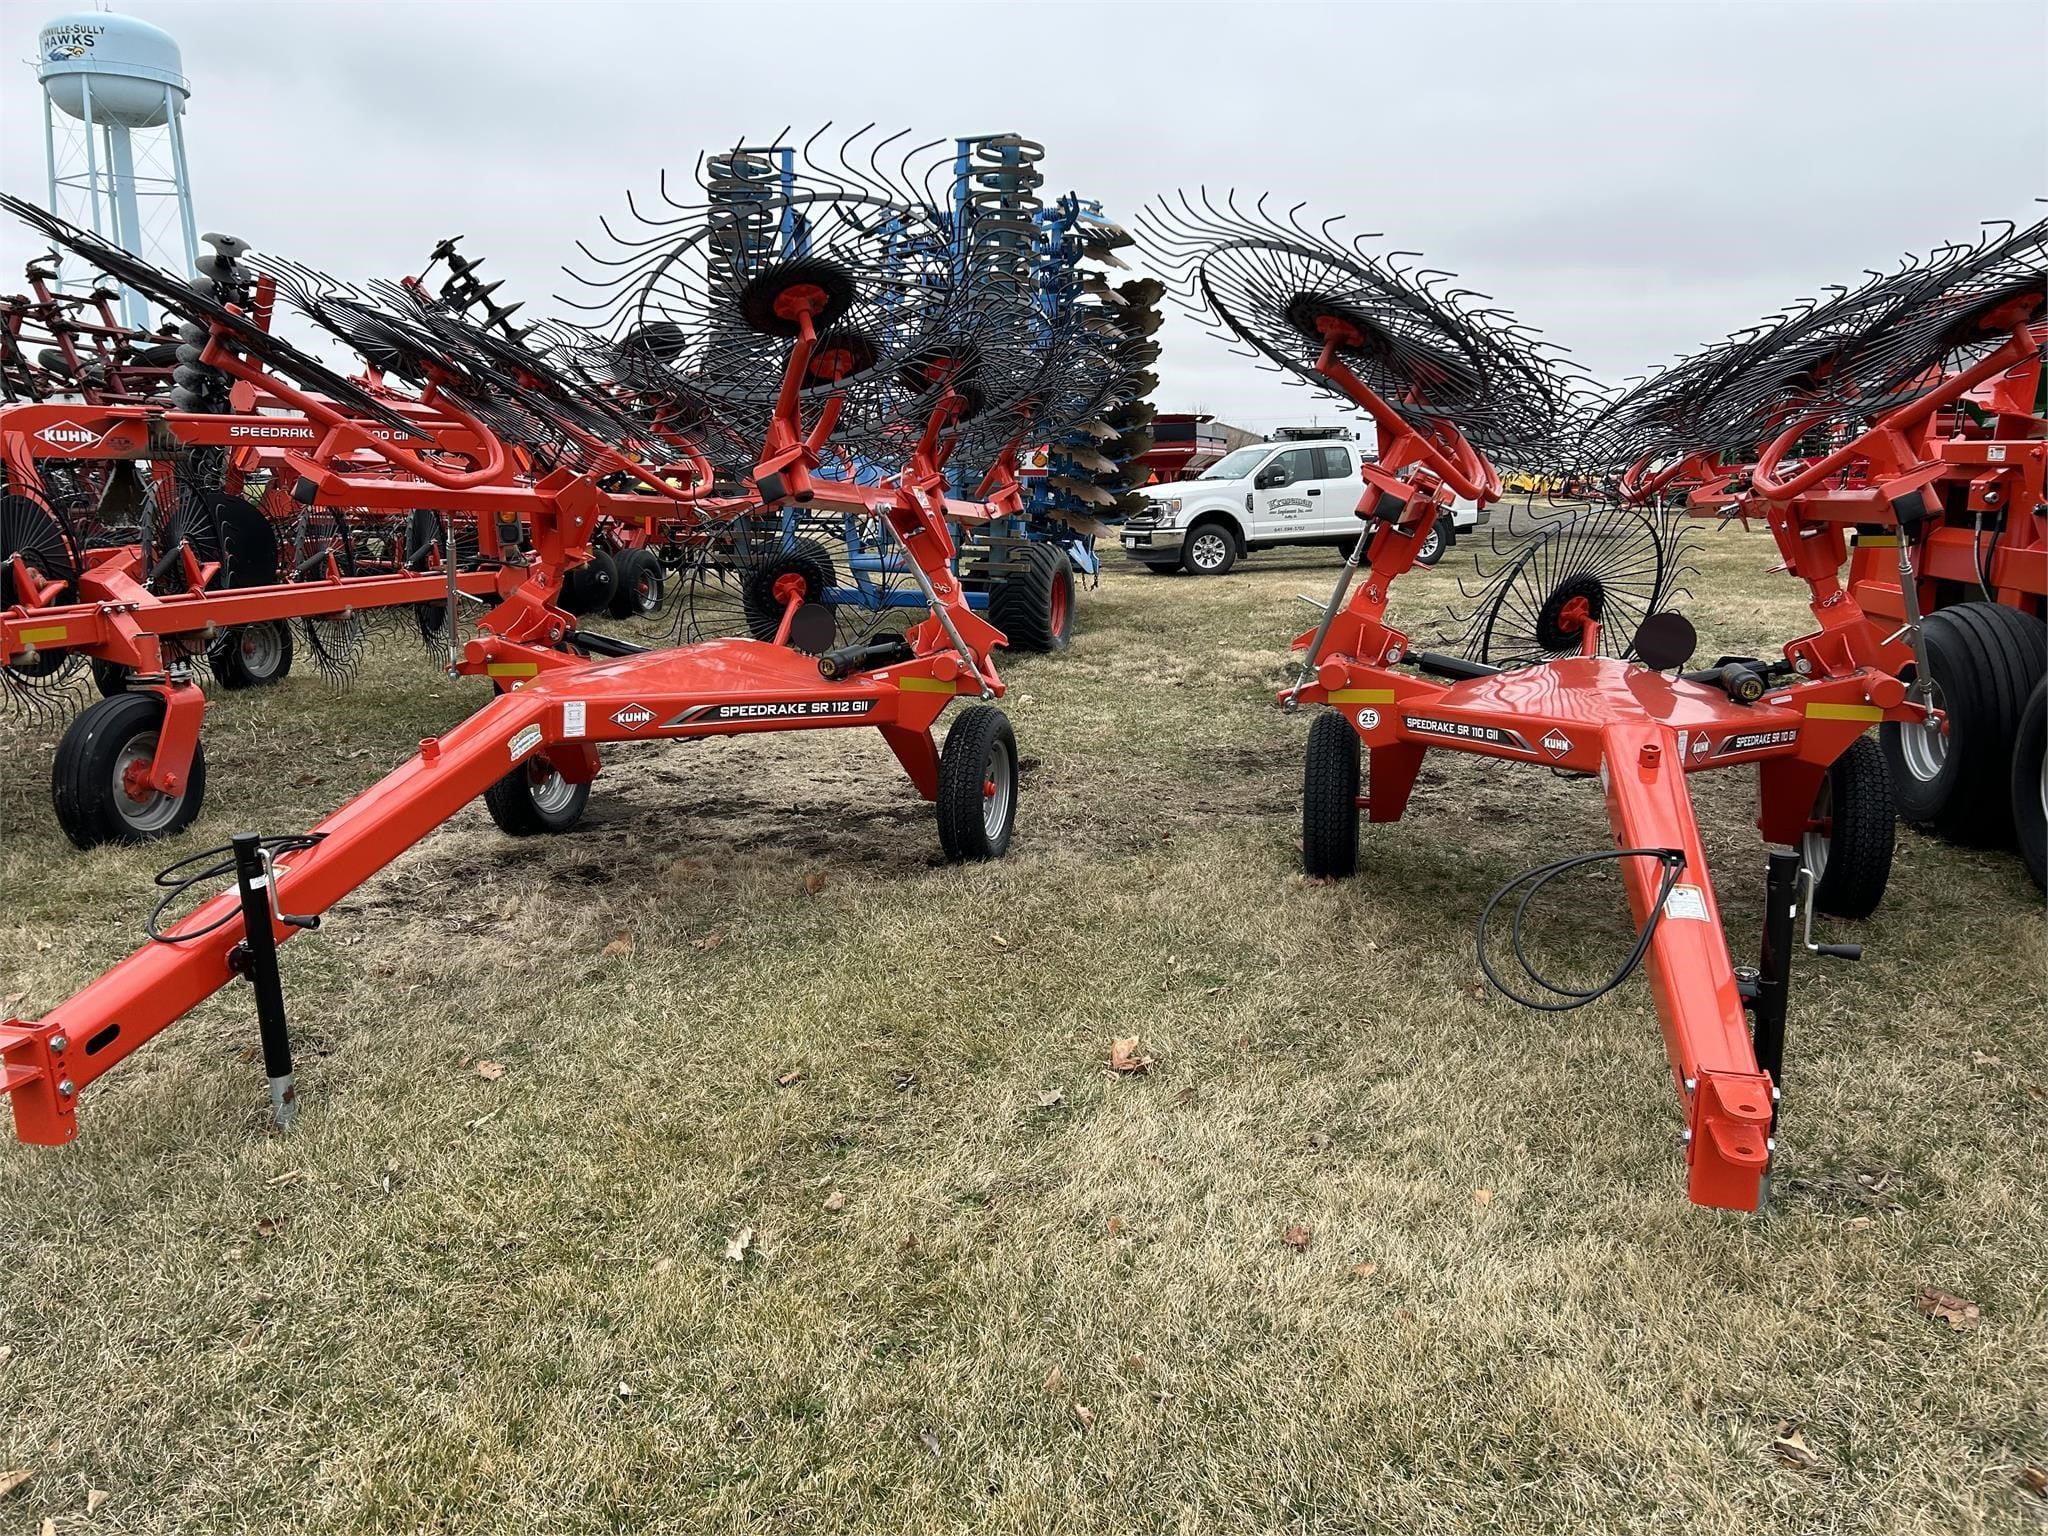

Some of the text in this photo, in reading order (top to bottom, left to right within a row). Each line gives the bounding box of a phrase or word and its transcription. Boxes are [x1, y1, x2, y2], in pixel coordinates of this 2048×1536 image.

[44, 34, 95, 49] HAWKS
[44, 429, 92, 442] KUHN
[369, 430, 390, 440] 00
[719, 700, 869, 718] SPEEDRAKE SR 112 GII
[617, 711, 650, 723] KUHN
[1361, 712, 1376, 722] 25
[1406, 717, 1499, 740] SPEEDRAKE SR 110 GII
[1544, 737, 1569, 751] KUHN
[1735, 732, 1771, 748] SPEEDRAKE
[1771, 732, 1781, 743] SR
